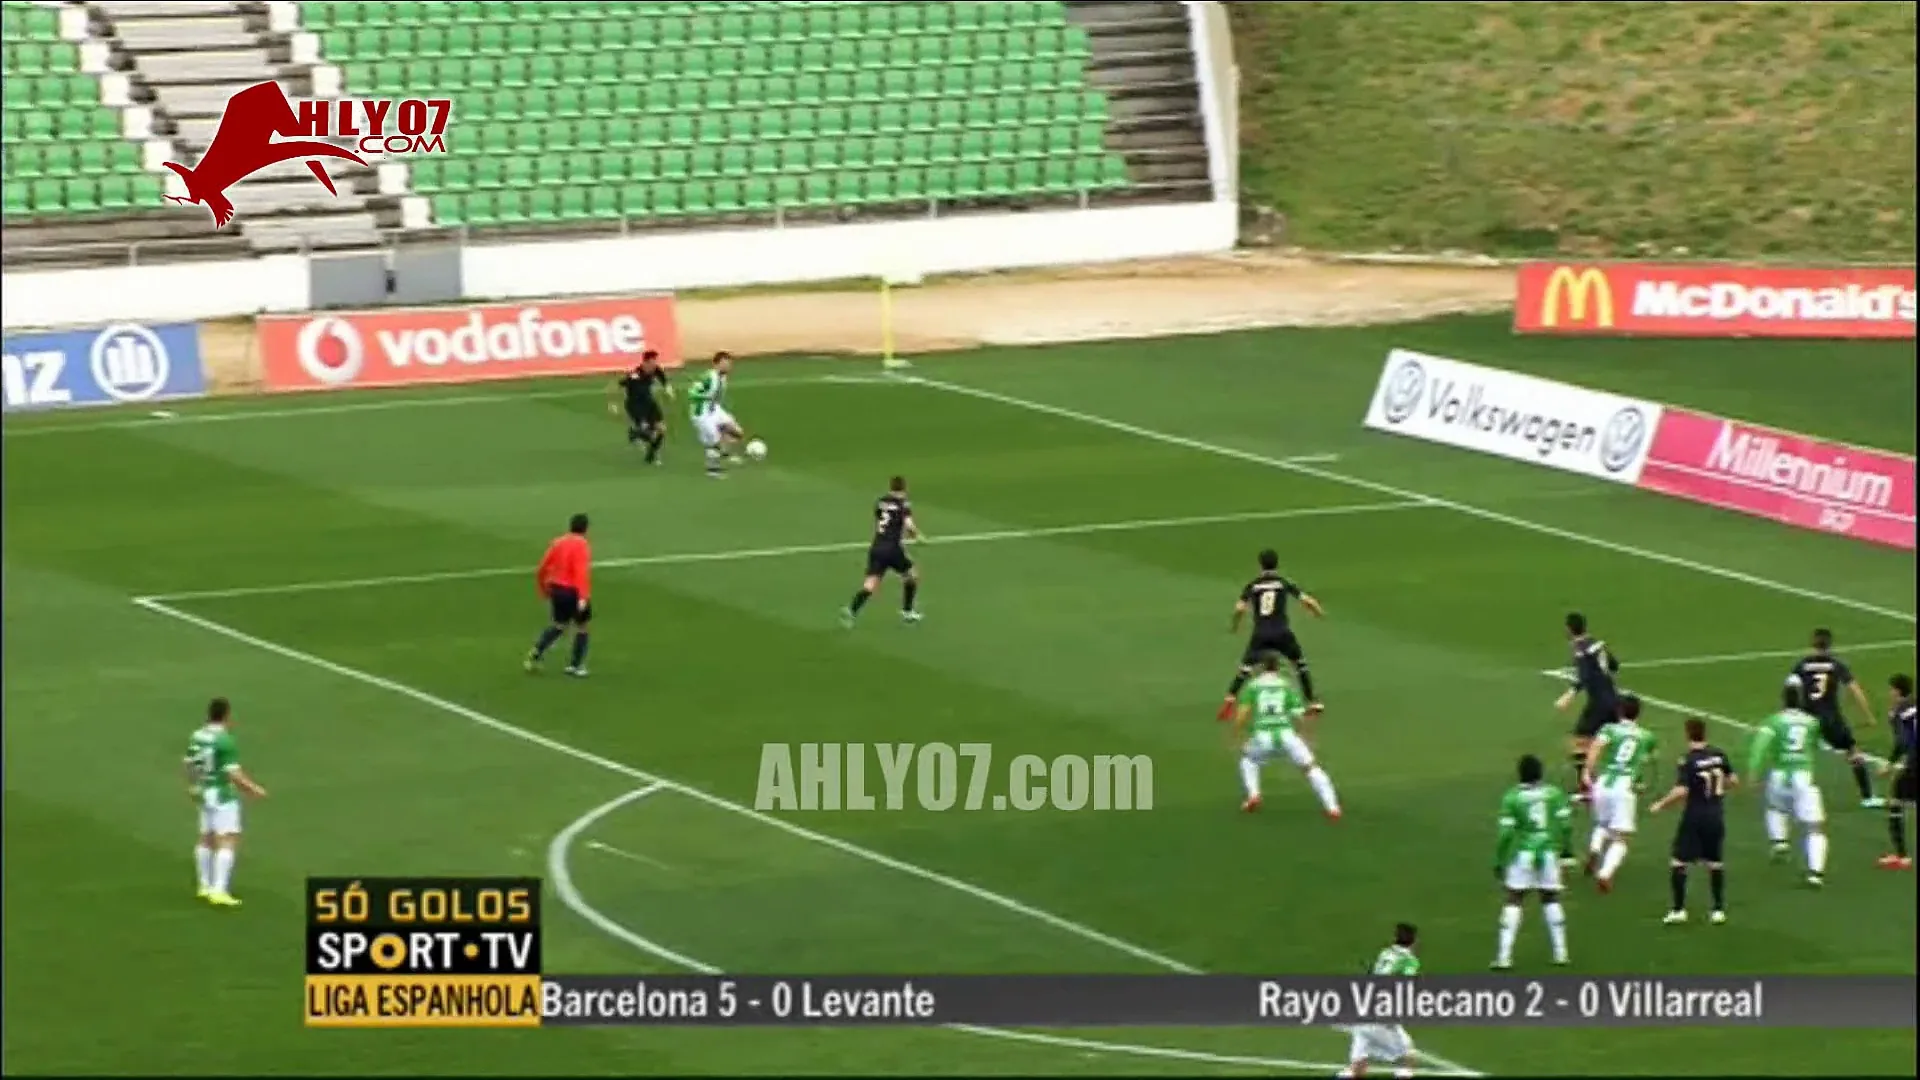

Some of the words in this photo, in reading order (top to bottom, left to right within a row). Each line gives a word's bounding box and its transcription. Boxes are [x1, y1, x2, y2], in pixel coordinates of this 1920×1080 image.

[376, 307, 645, 367] vodafone
[1427, 377, 1596, 457] Volkswagen
[1704, 419, 1893, 508] Millennium
